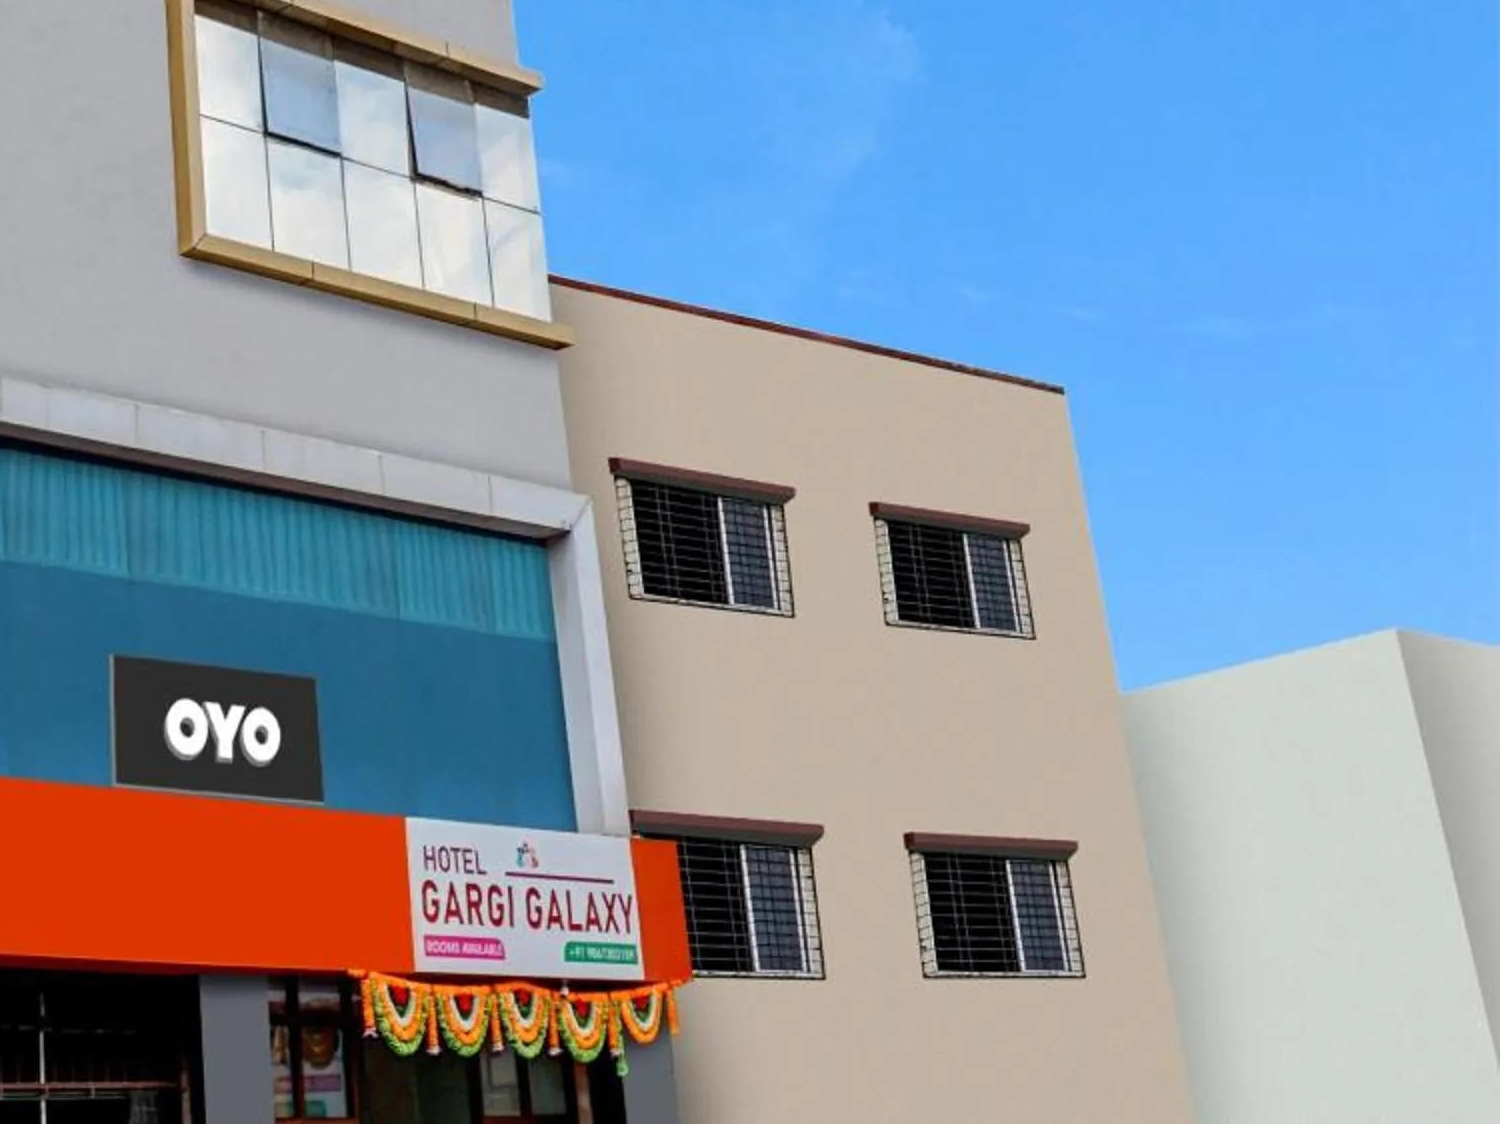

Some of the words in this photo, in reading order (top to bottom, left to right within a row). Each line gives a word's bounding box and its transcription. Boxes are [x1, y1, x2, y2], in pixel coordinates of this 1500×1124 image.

[164, 697, 281, 768] OYO
[423, 845, 487, 875] HOTEL
[421, 879, 515, 928] GARGI
[525, 886, 632, 934] GALAXY
[426, 939, 460, 955] ROOMS
